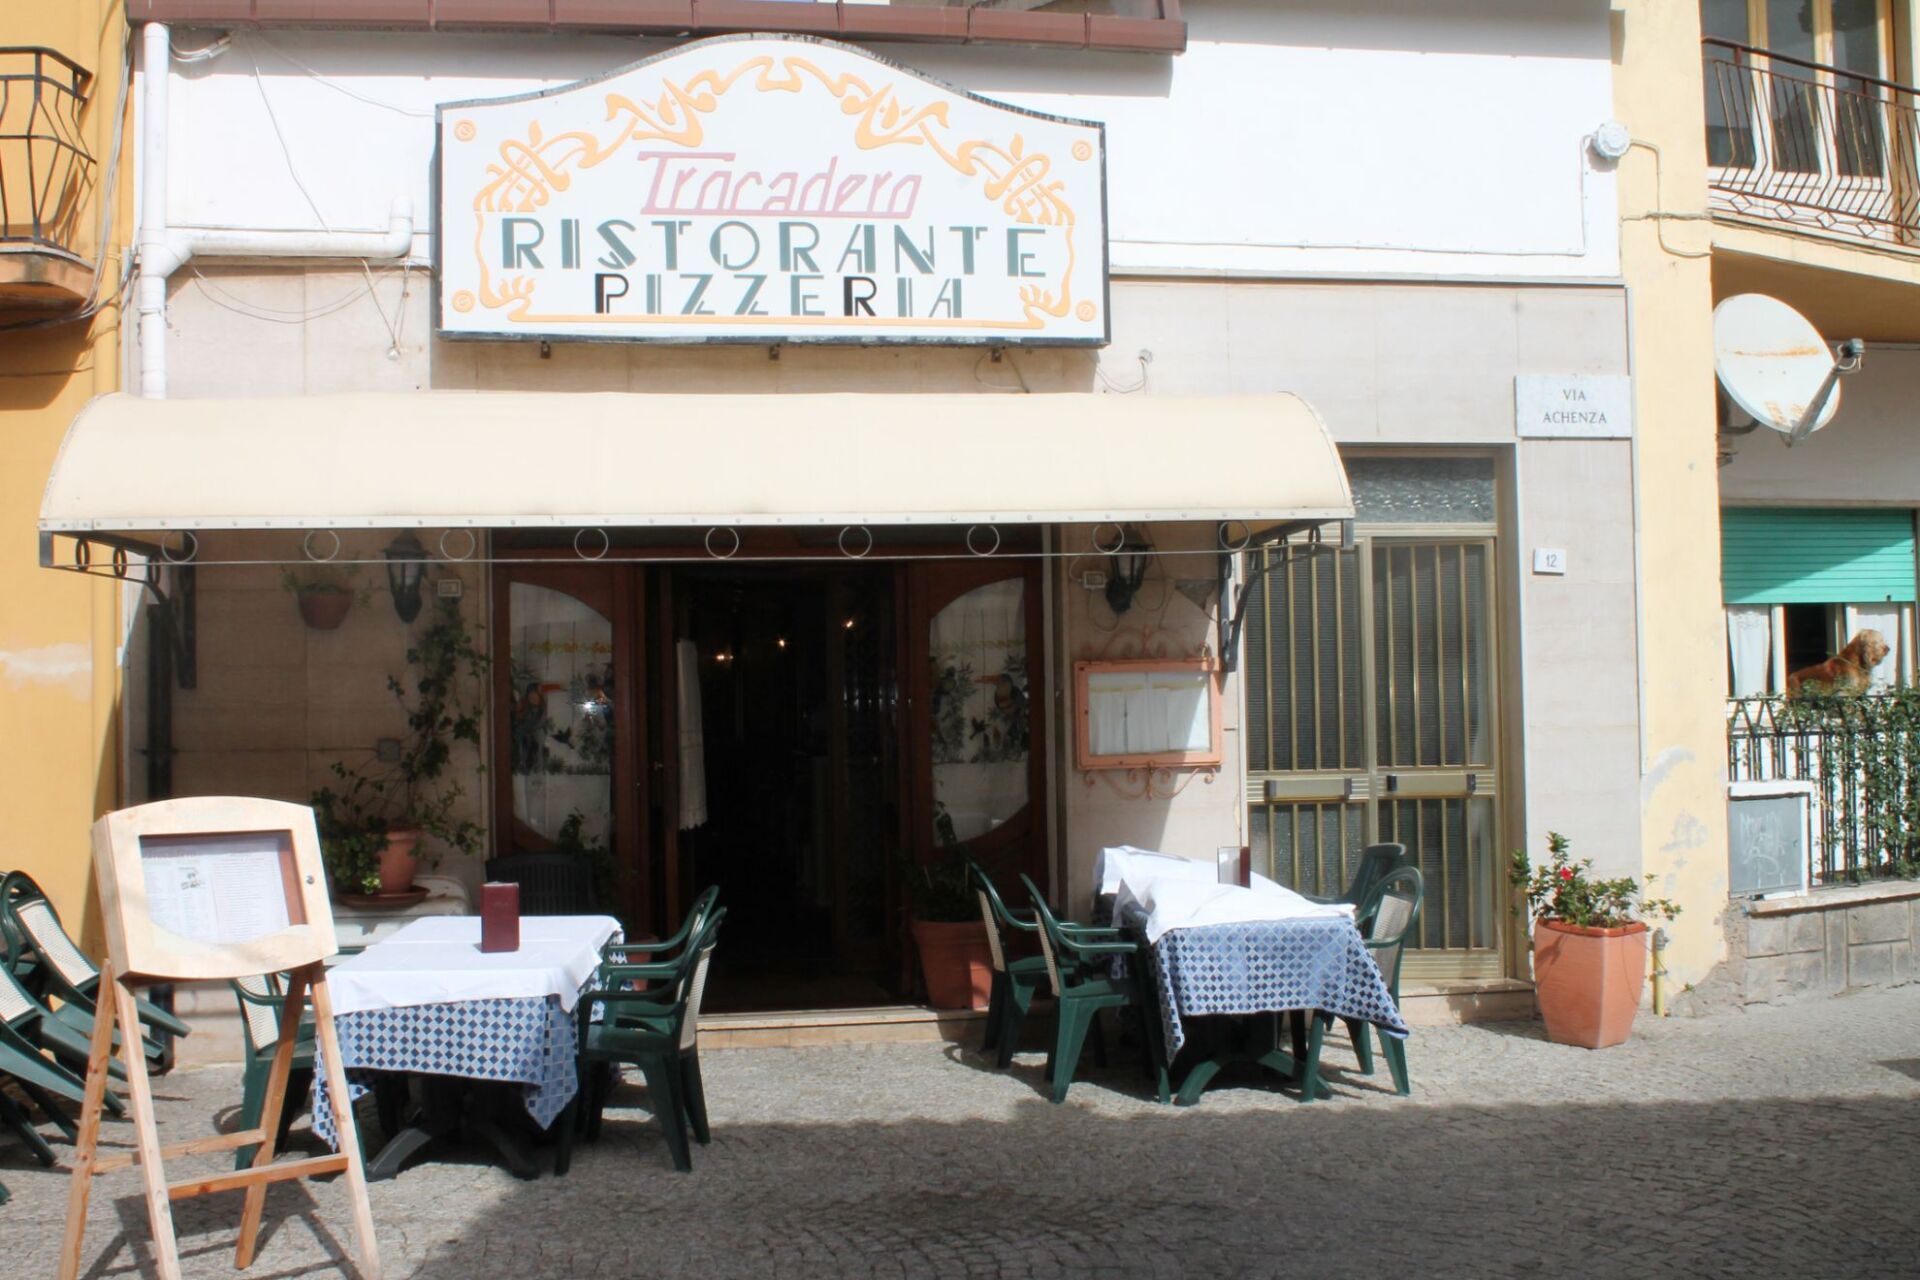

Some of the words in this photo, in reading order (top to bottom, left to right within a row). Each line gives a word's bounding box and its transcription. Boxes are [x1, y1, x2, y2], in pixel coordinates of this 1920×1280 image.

[638, 151, 922, 218] Trocadero
[502, 218, 1045, 276] RISTORANTE
[594, 273, 962, 318] PIZZERIA
[1563, 389, 1586, 401] VIA
[1543, 411, 1607, 424] ACHENZA
[1546, 553, 1557, 568] 12
